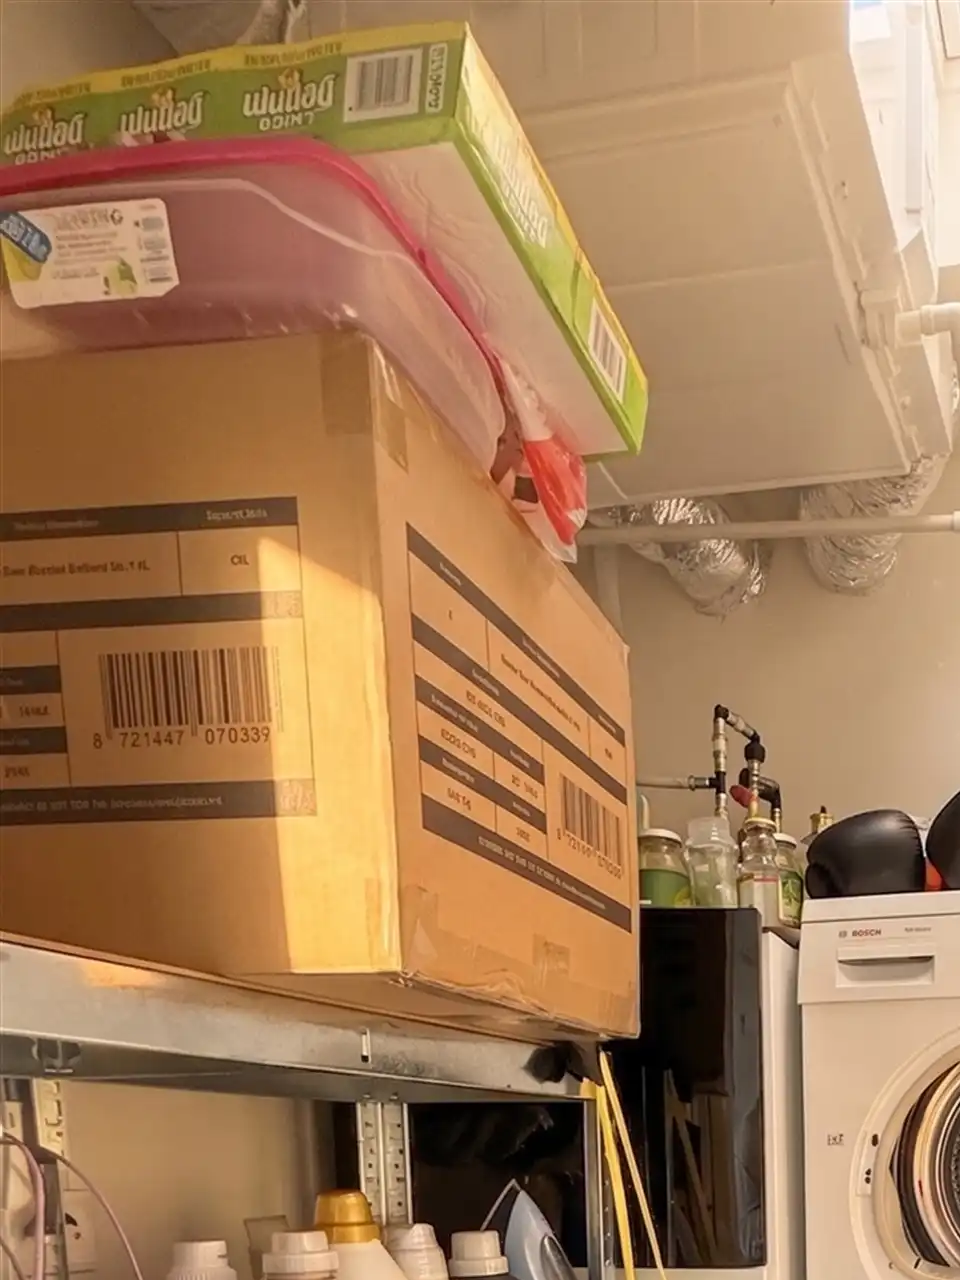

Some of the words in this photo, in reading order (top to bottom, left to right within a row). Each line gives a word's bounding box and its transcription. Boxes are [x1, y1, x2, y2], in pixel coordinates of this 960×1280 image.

[93, 732, 103, 749] 8
[119, 729, 185, 748] 721447
[205, 726, 271, 745] 070339
